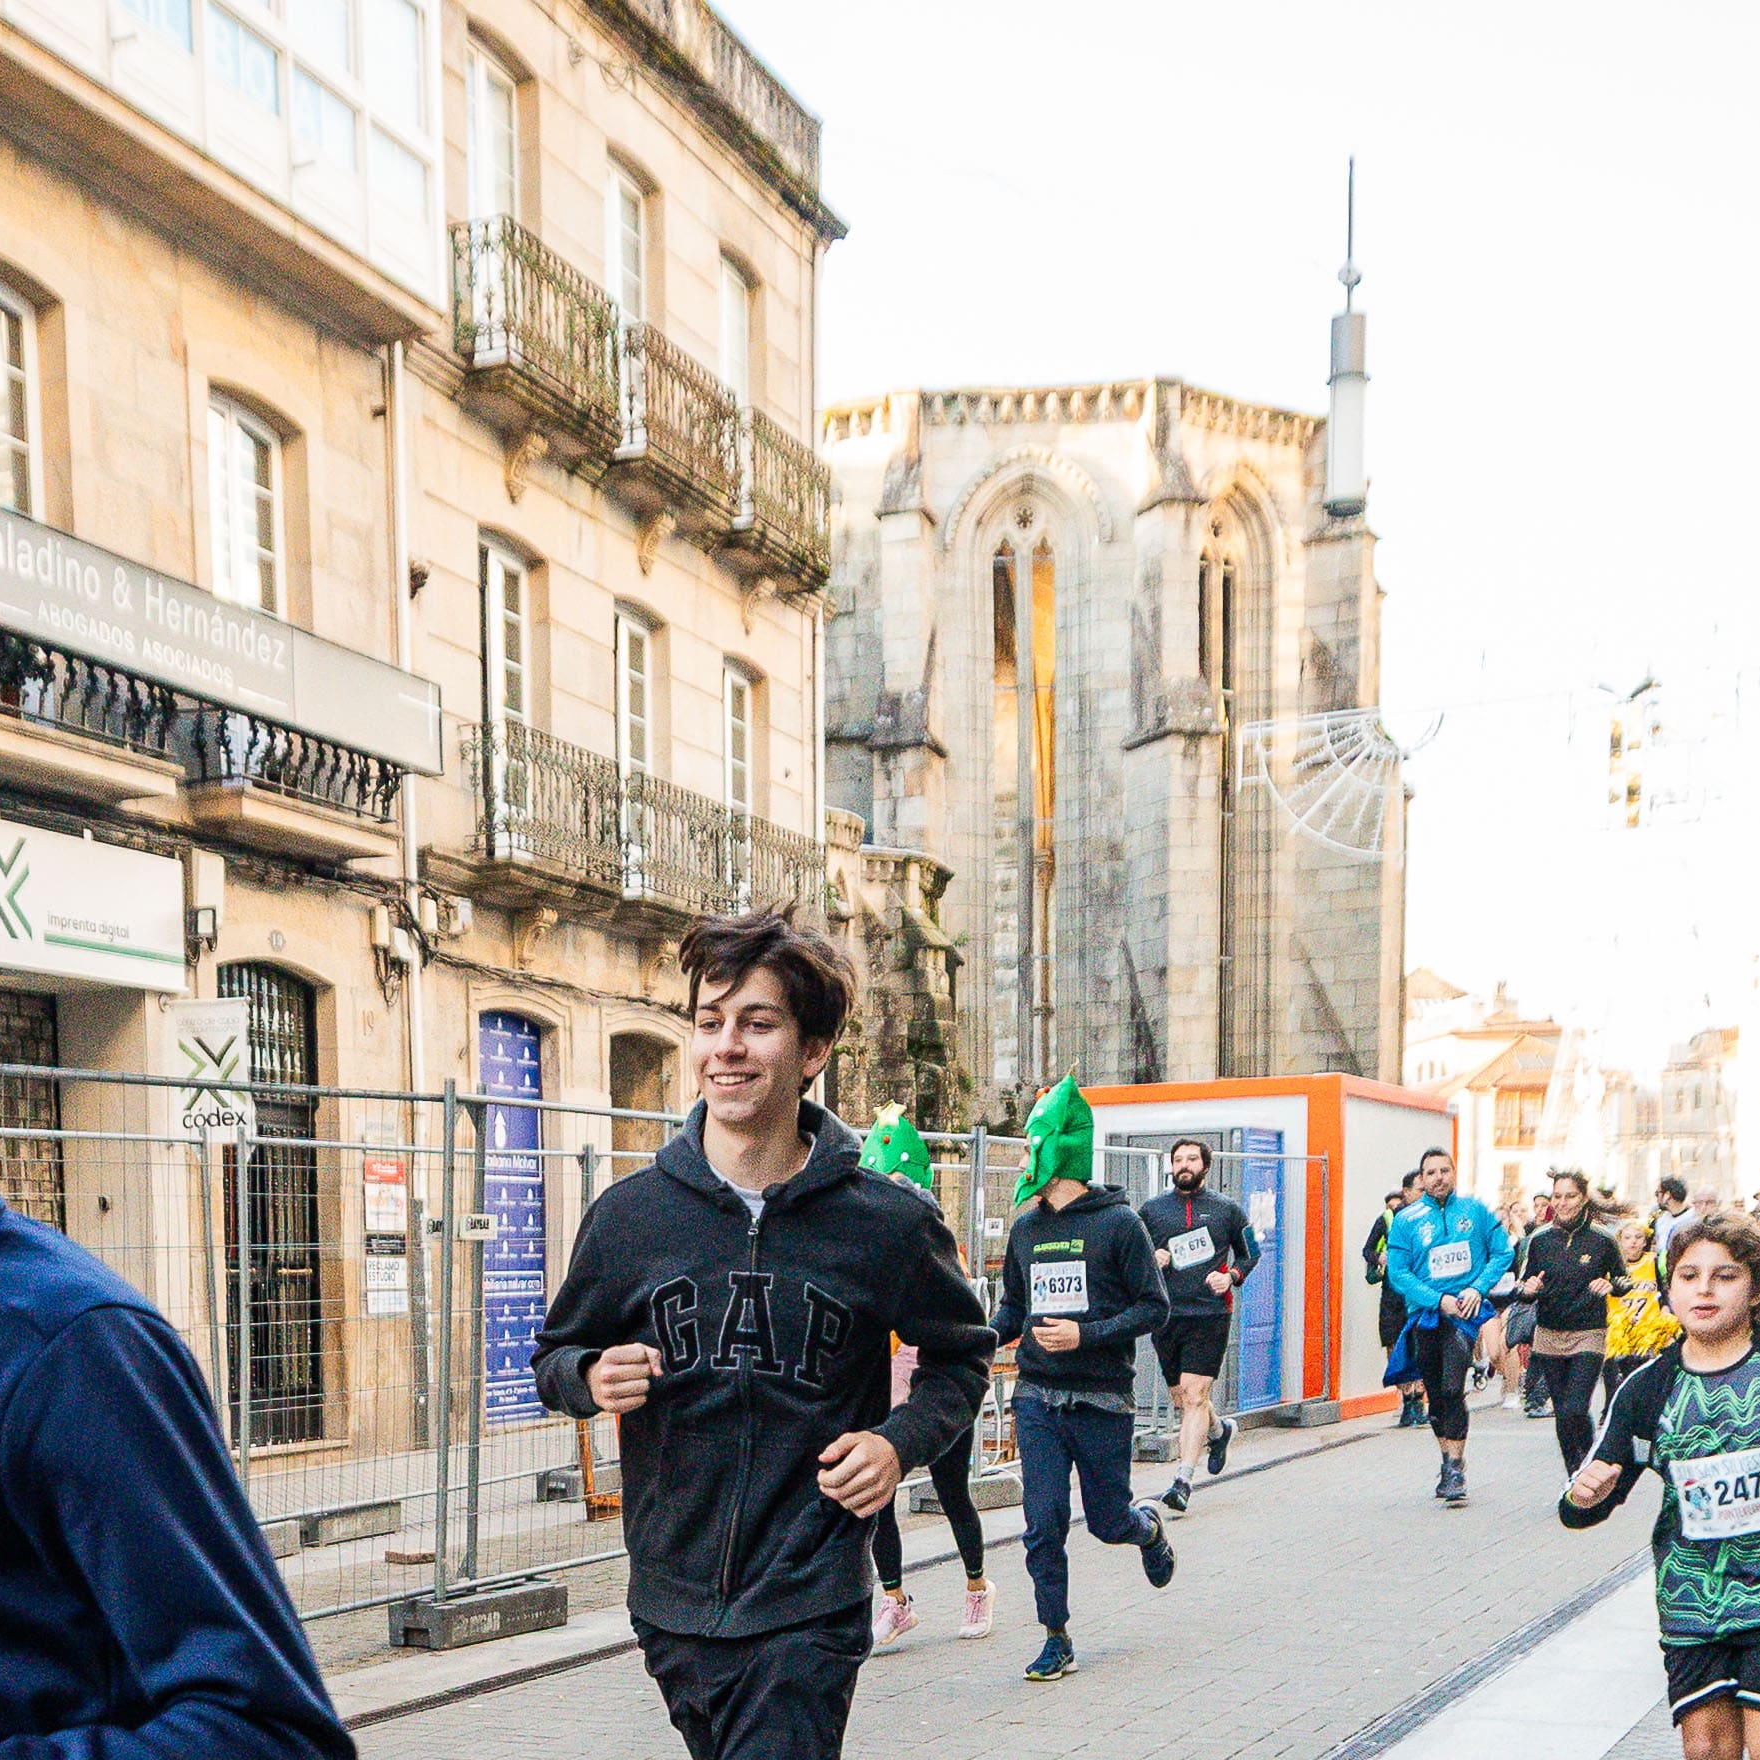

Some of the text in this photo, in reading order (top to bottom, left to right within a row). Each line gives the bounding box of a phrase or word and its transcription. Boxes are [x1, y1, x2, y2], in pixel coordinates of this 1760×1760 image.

[112, 566, 133, 610] &
[144, 576, 286, 670] Hernández
[38, 601, 234, 690] ABOGADOS ASOCIADOS
[47, 911, 130, 942] imprenta digital
[182, 1106, 248, 1129] códex
[1188, 1236, 1207, 1251] 676
[1048, 1276, 1083, 1294] 6373
[650, 1270, 855, 1388] GAP
